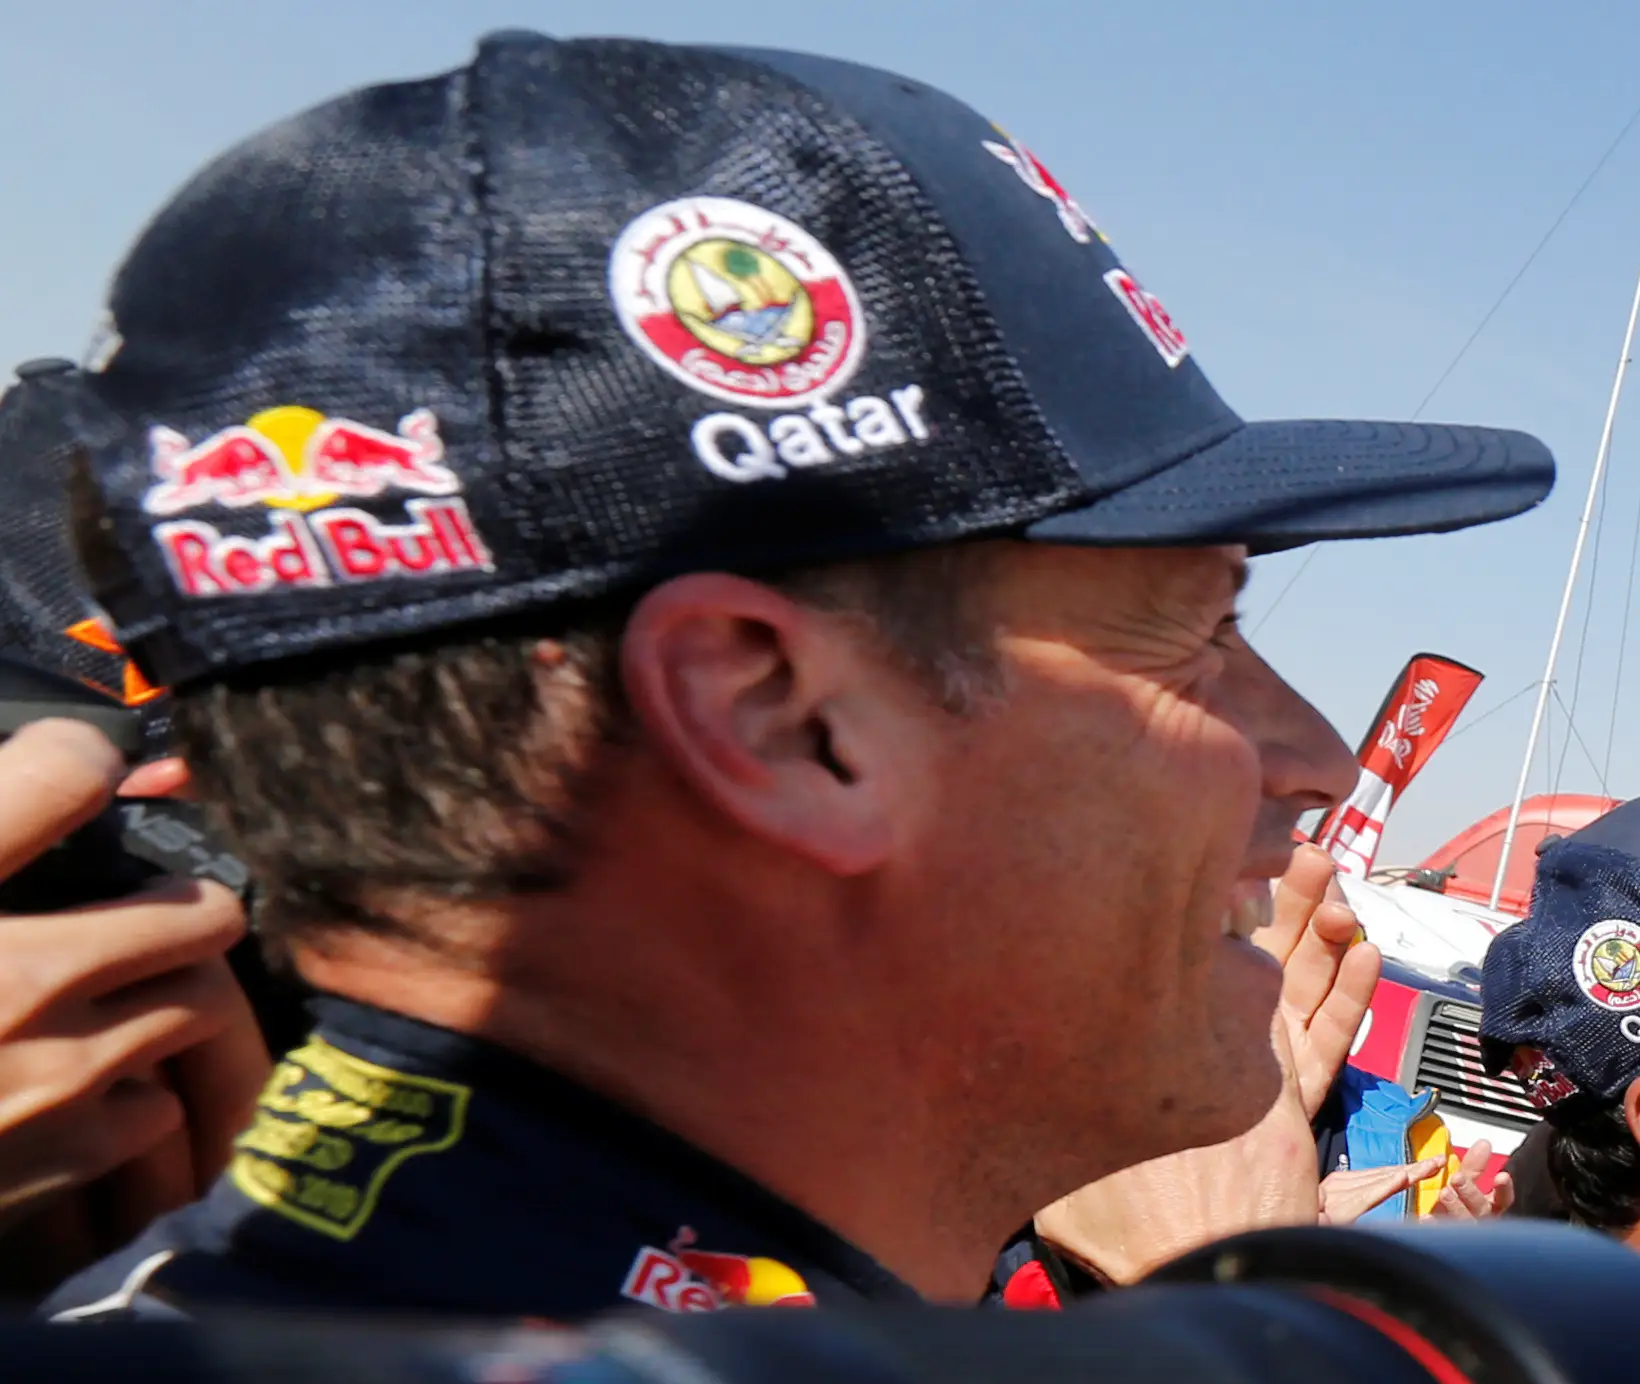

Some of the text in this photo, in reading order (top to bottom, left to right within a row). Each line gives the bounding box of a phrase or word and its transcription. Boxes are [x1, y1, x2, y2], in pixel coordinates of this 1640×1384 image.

[691, 384, 929, 483] Qatar
[154, 499, 492, 596] Red Bull
